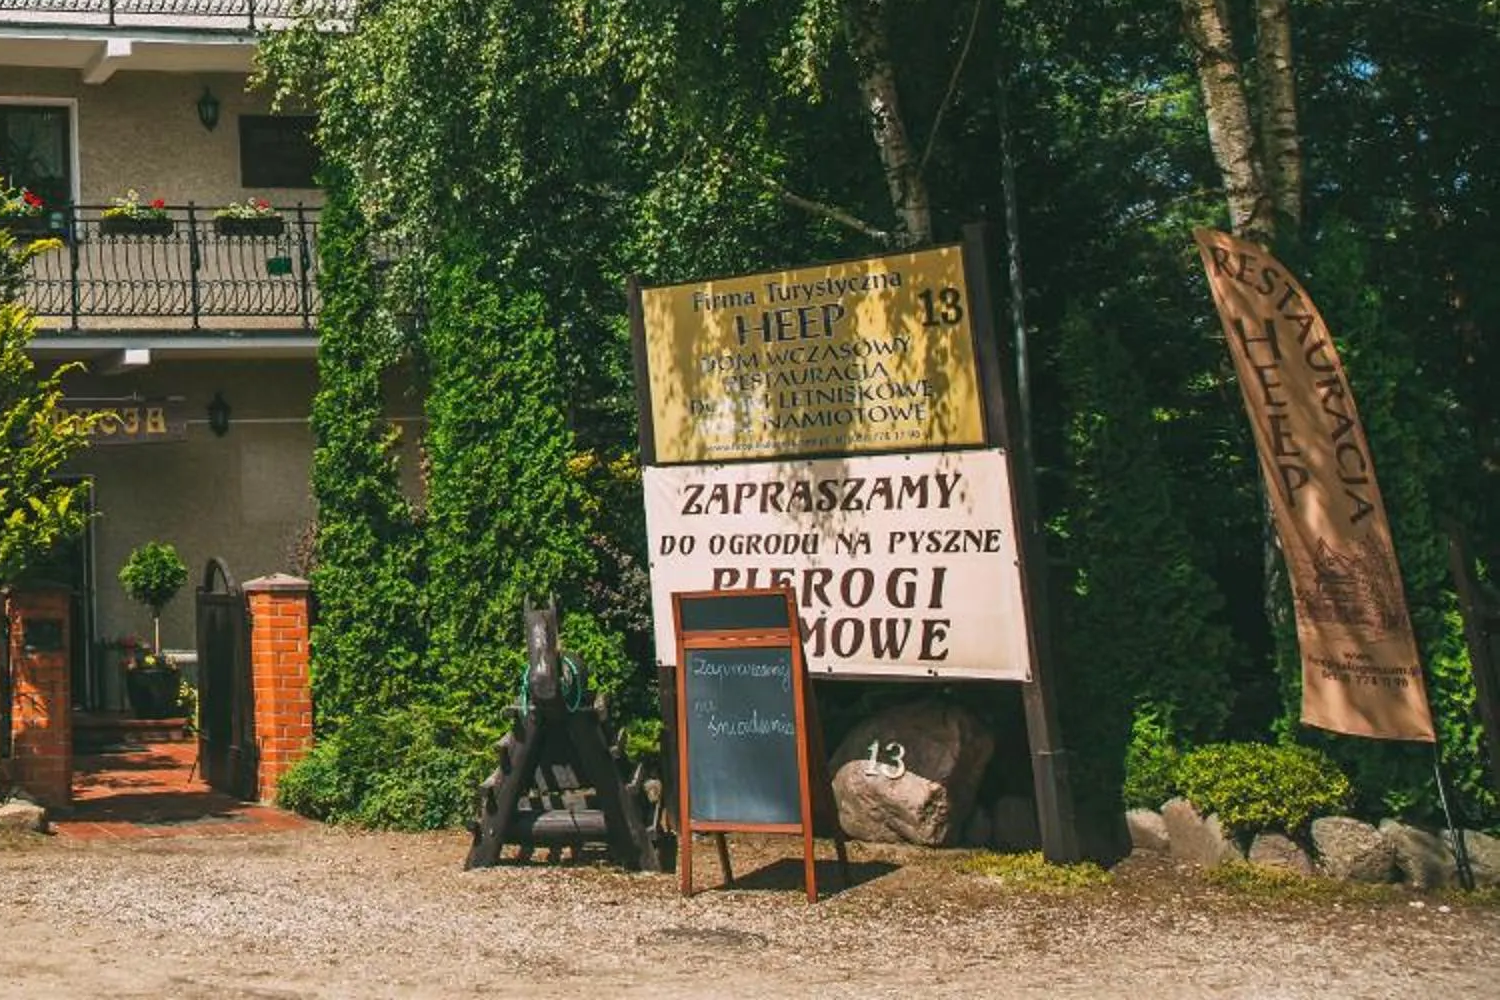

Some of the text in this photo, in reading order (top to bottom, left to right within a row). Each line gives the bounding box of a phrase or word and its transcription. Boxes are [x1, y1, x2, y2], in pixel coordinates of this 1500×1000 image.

[692, 269, 902, 313] Firma Turystyczna
[917, 287, 964, 328] 13
[735, 302, 847, 346] HEEP
[765, 335, 912, 367] WCZASOWY
[778, 379, 935, 410] LETNISKOWE
[1209, 244, 1375, 525] RESTAURACJA
[762, 404, 928, 431] NAMIOTOWE
[1233, 317, 1311, 508] HEEP
[680, 472, 963, 516] ZAPRASZAMY
[659, 528, 1003, 557] DO OGRODU NA PYSZNE
[711, 566, 948, 610] PIEROGI
[866, 739, 906, 780] 13
